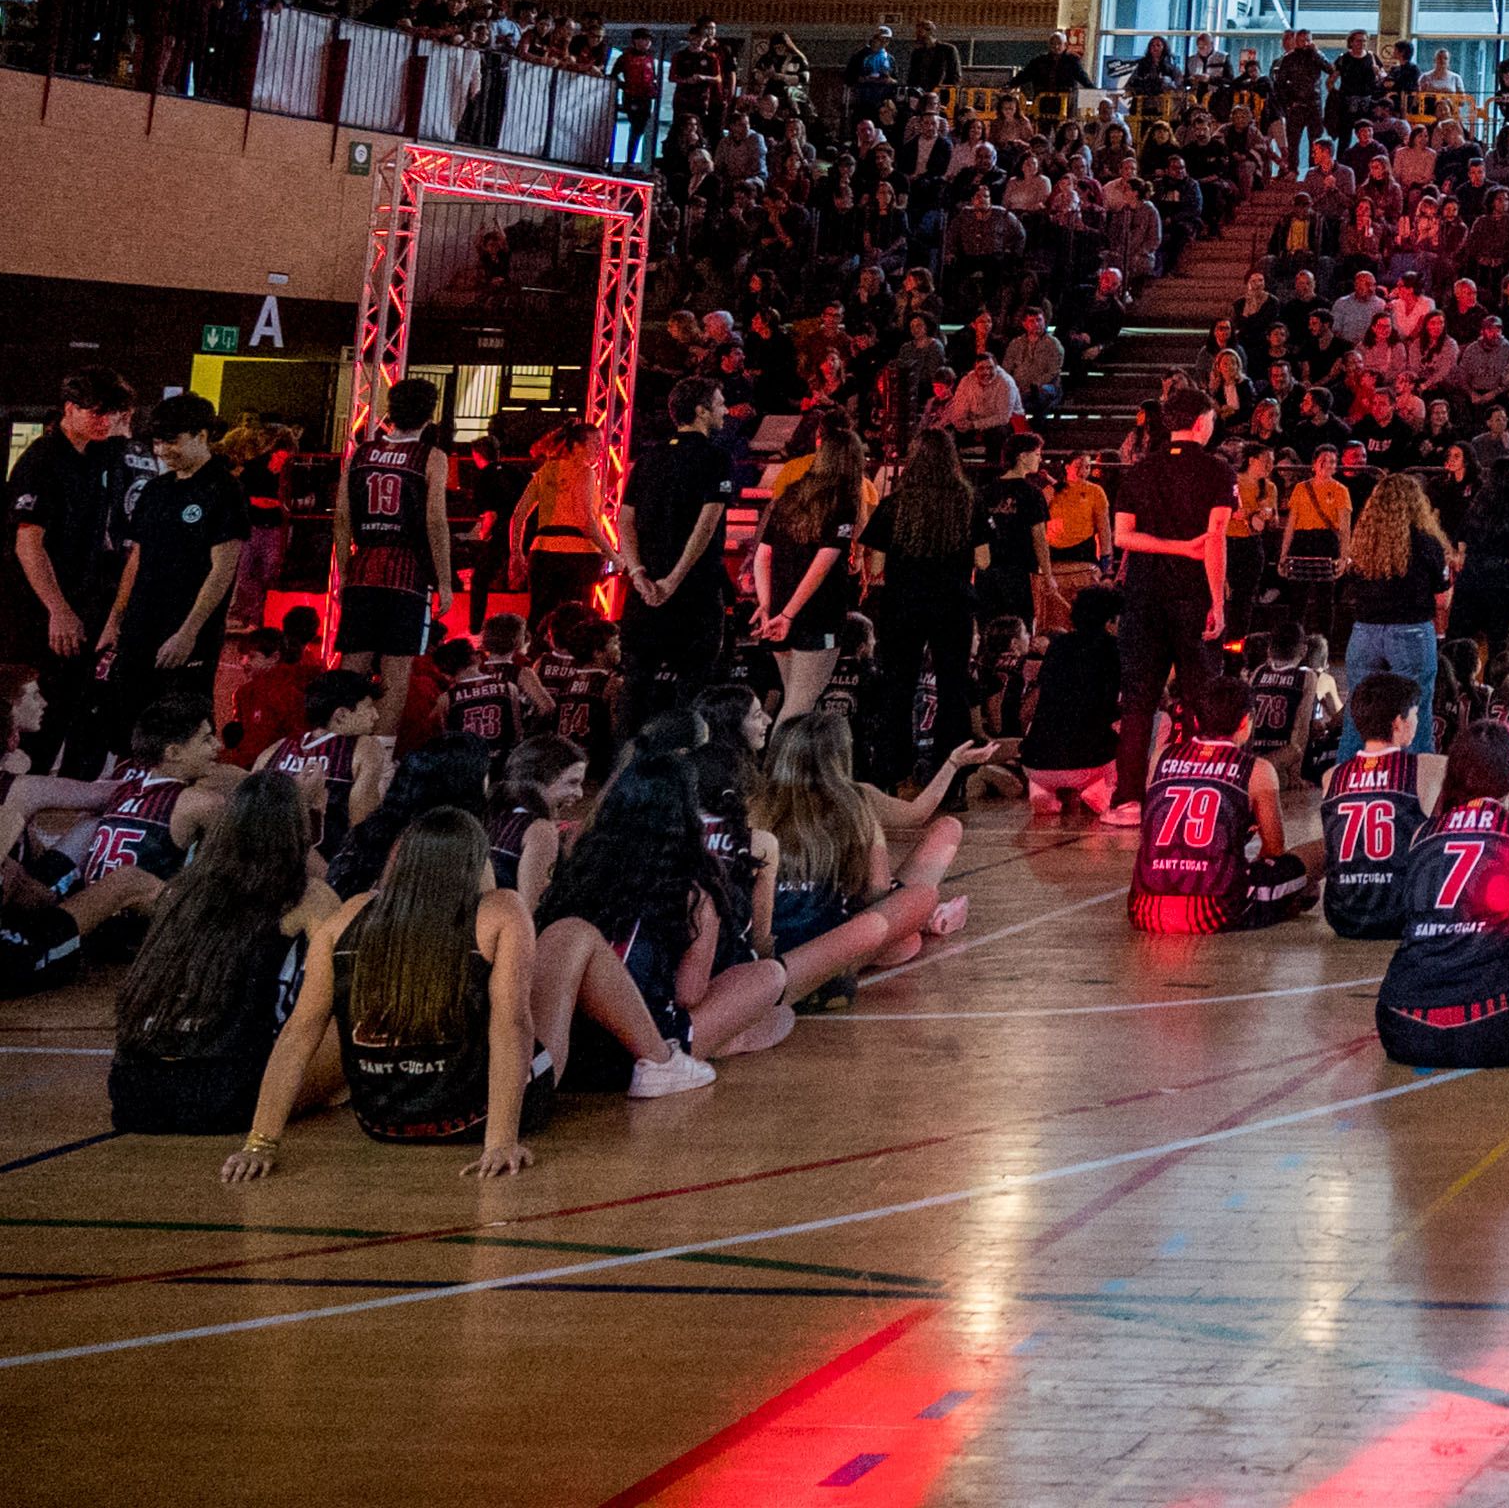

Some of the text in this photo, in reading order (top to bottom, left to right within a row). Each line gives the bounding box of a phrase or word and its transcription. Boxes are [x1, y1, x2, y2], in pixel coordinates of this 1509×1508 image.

[248, 295, 285, 348] A
[369, 448, 407, 465] DAVID
[366, 472, 403, 517] 19
[455, 683, 507, 702] ALBERT
[1161, 758, 1224, 774] CRISTIAN
[1348, 770, 1389, 789] LIAM
[1155, 785, 1222, 848] 79
[1448, 810, 1494, 830] MAR
[1337, 798, 1396, 863] 76
[1152, 859, 1178, 871] SANT
[1434, 840, 1485, 910] 7
[358, 1059, 446, 1075] SANT CUGAT
